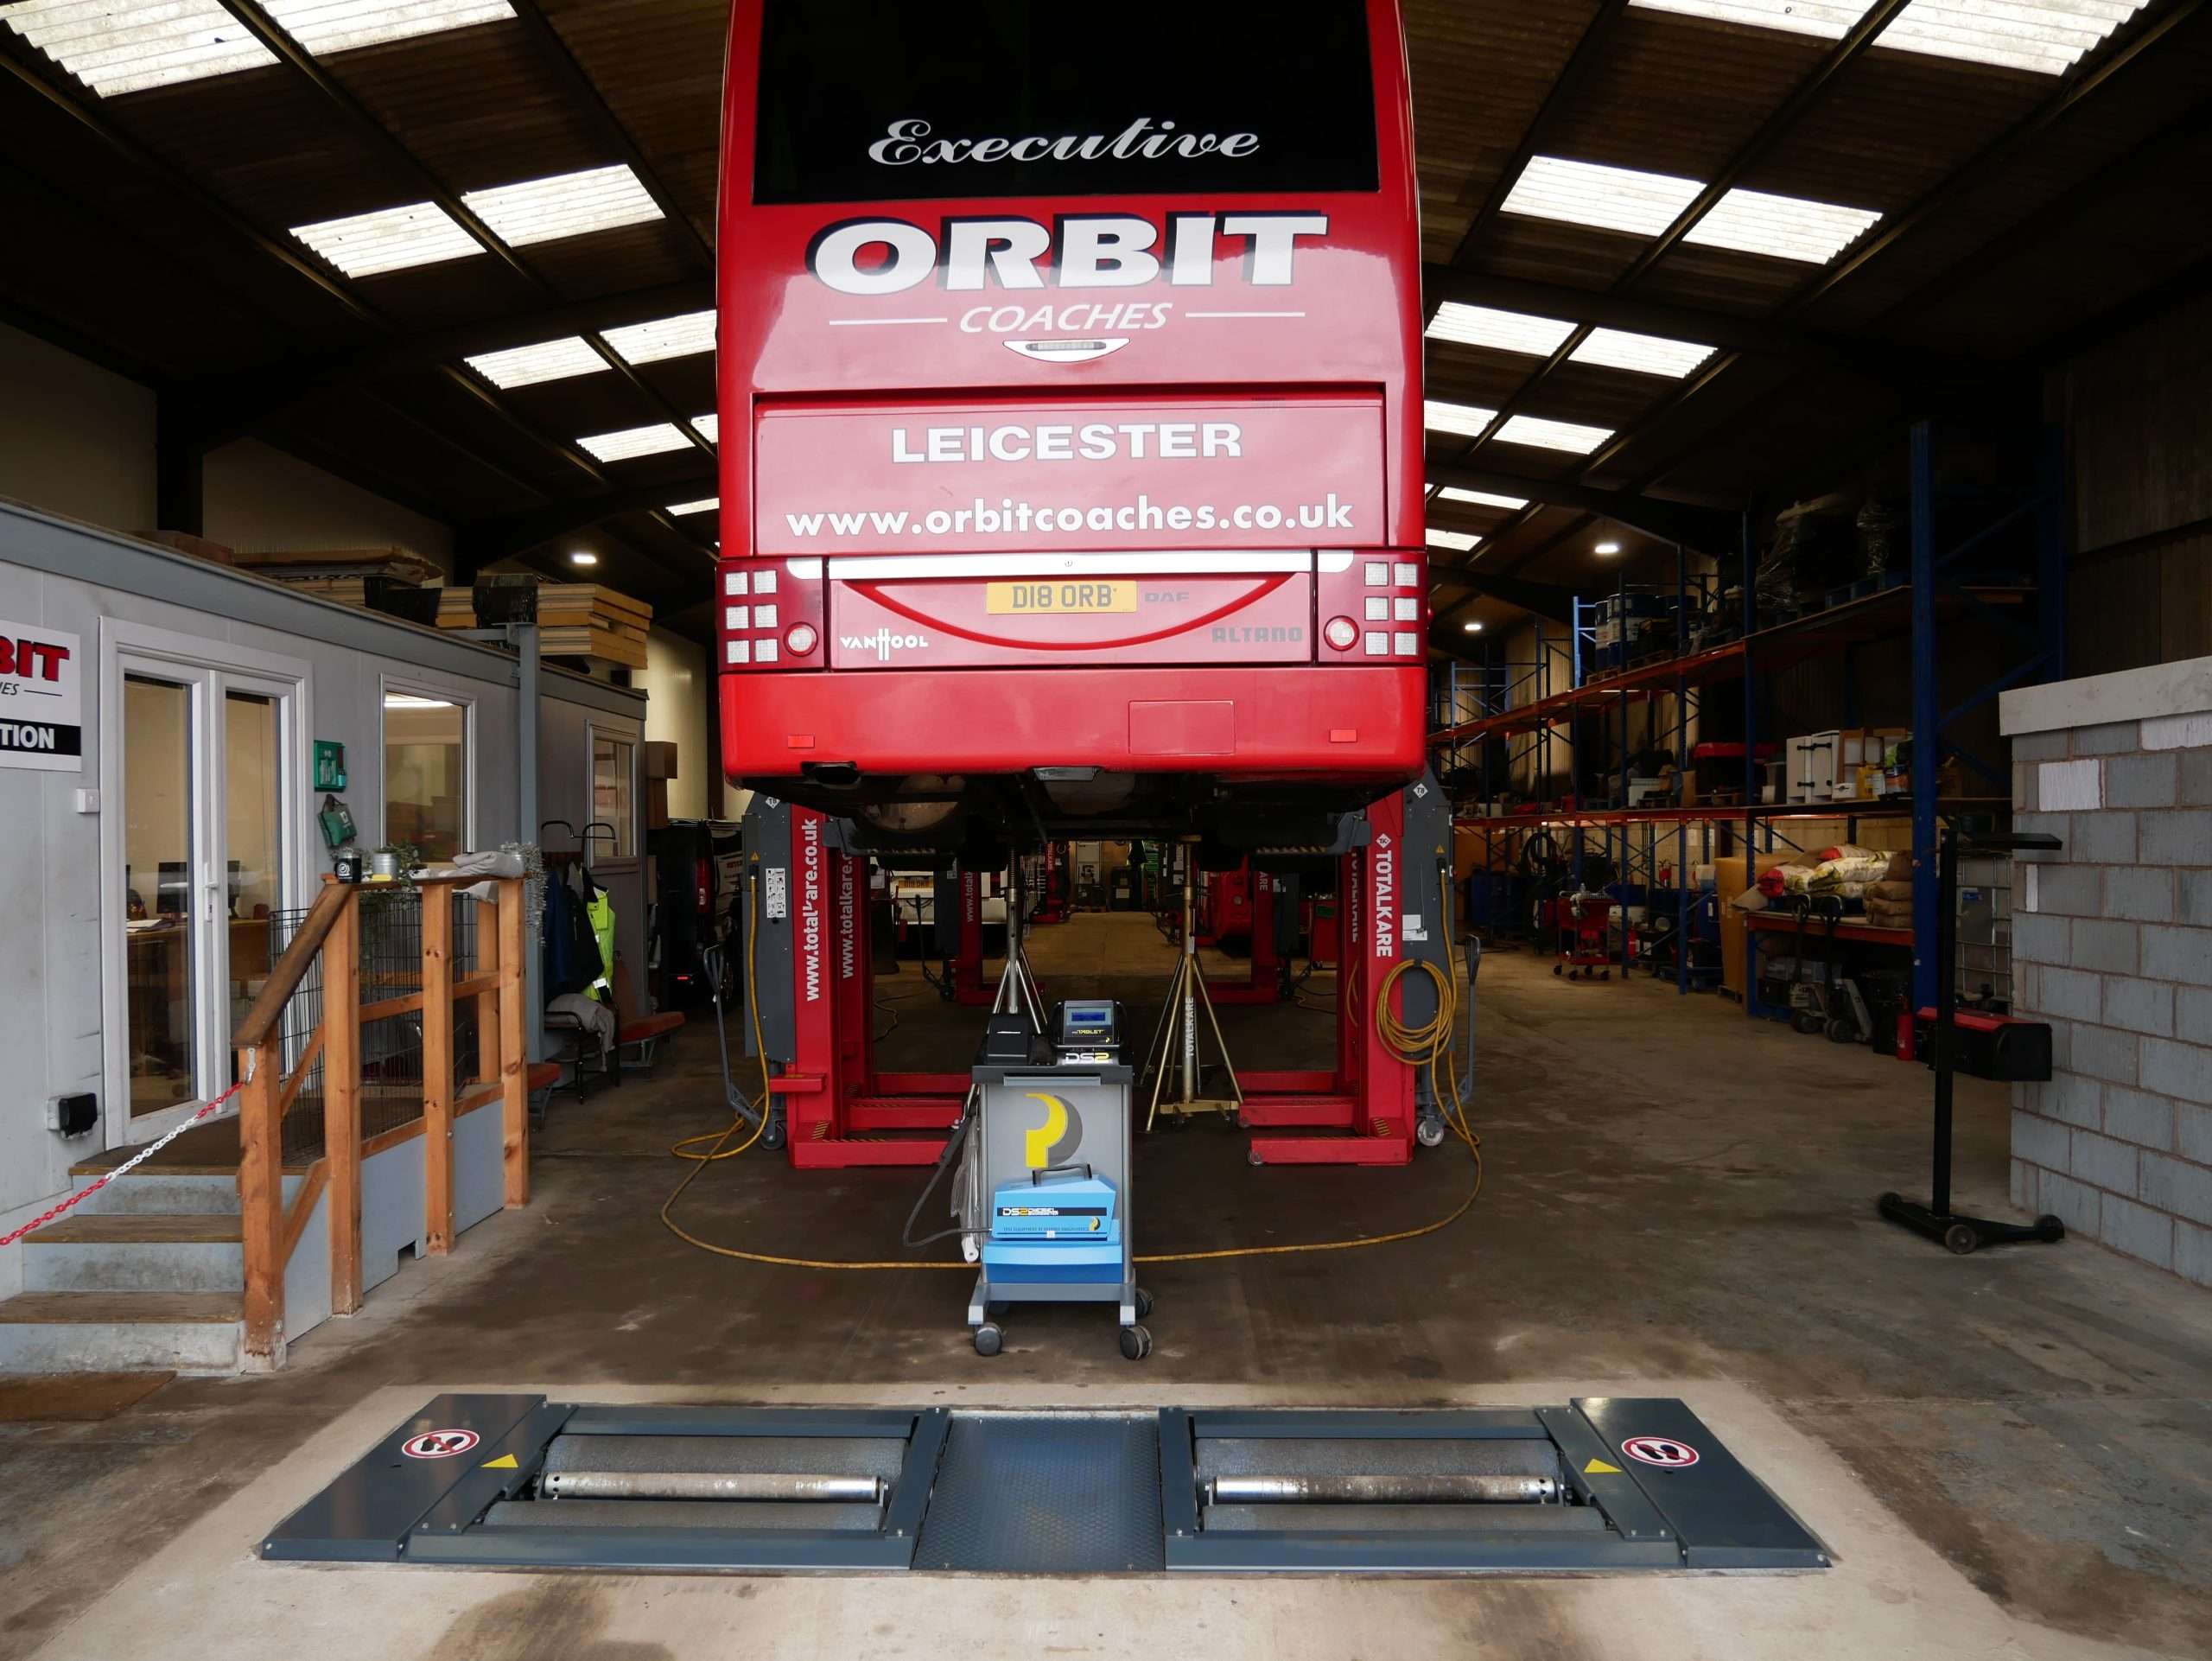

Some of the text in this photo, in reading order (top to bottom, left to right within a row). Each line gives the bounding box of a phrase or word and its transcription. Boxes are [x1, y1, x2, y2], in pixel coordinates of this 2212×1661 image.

[868, 118, 1260, 164] Executive
[809, 212, 1329, 296] ORBIT
[960, 302, 1173, 333] COACHES
[891, 422, 1243, 463] LEICESTER
[785, 493, 1355, 538] www.orbitcoaches.co.uk
[1012, 584, 1112, 608] D18 ORB
[1145, 592, 1190, 602] DAF
[1211, 627, 1303, 642] ALTANO
[1376, 850, 1392, 957] TOTALKARE
[1065, 1053, 1109, 1064] DS2
[1002, 1207, 1029, 1216] DS2
